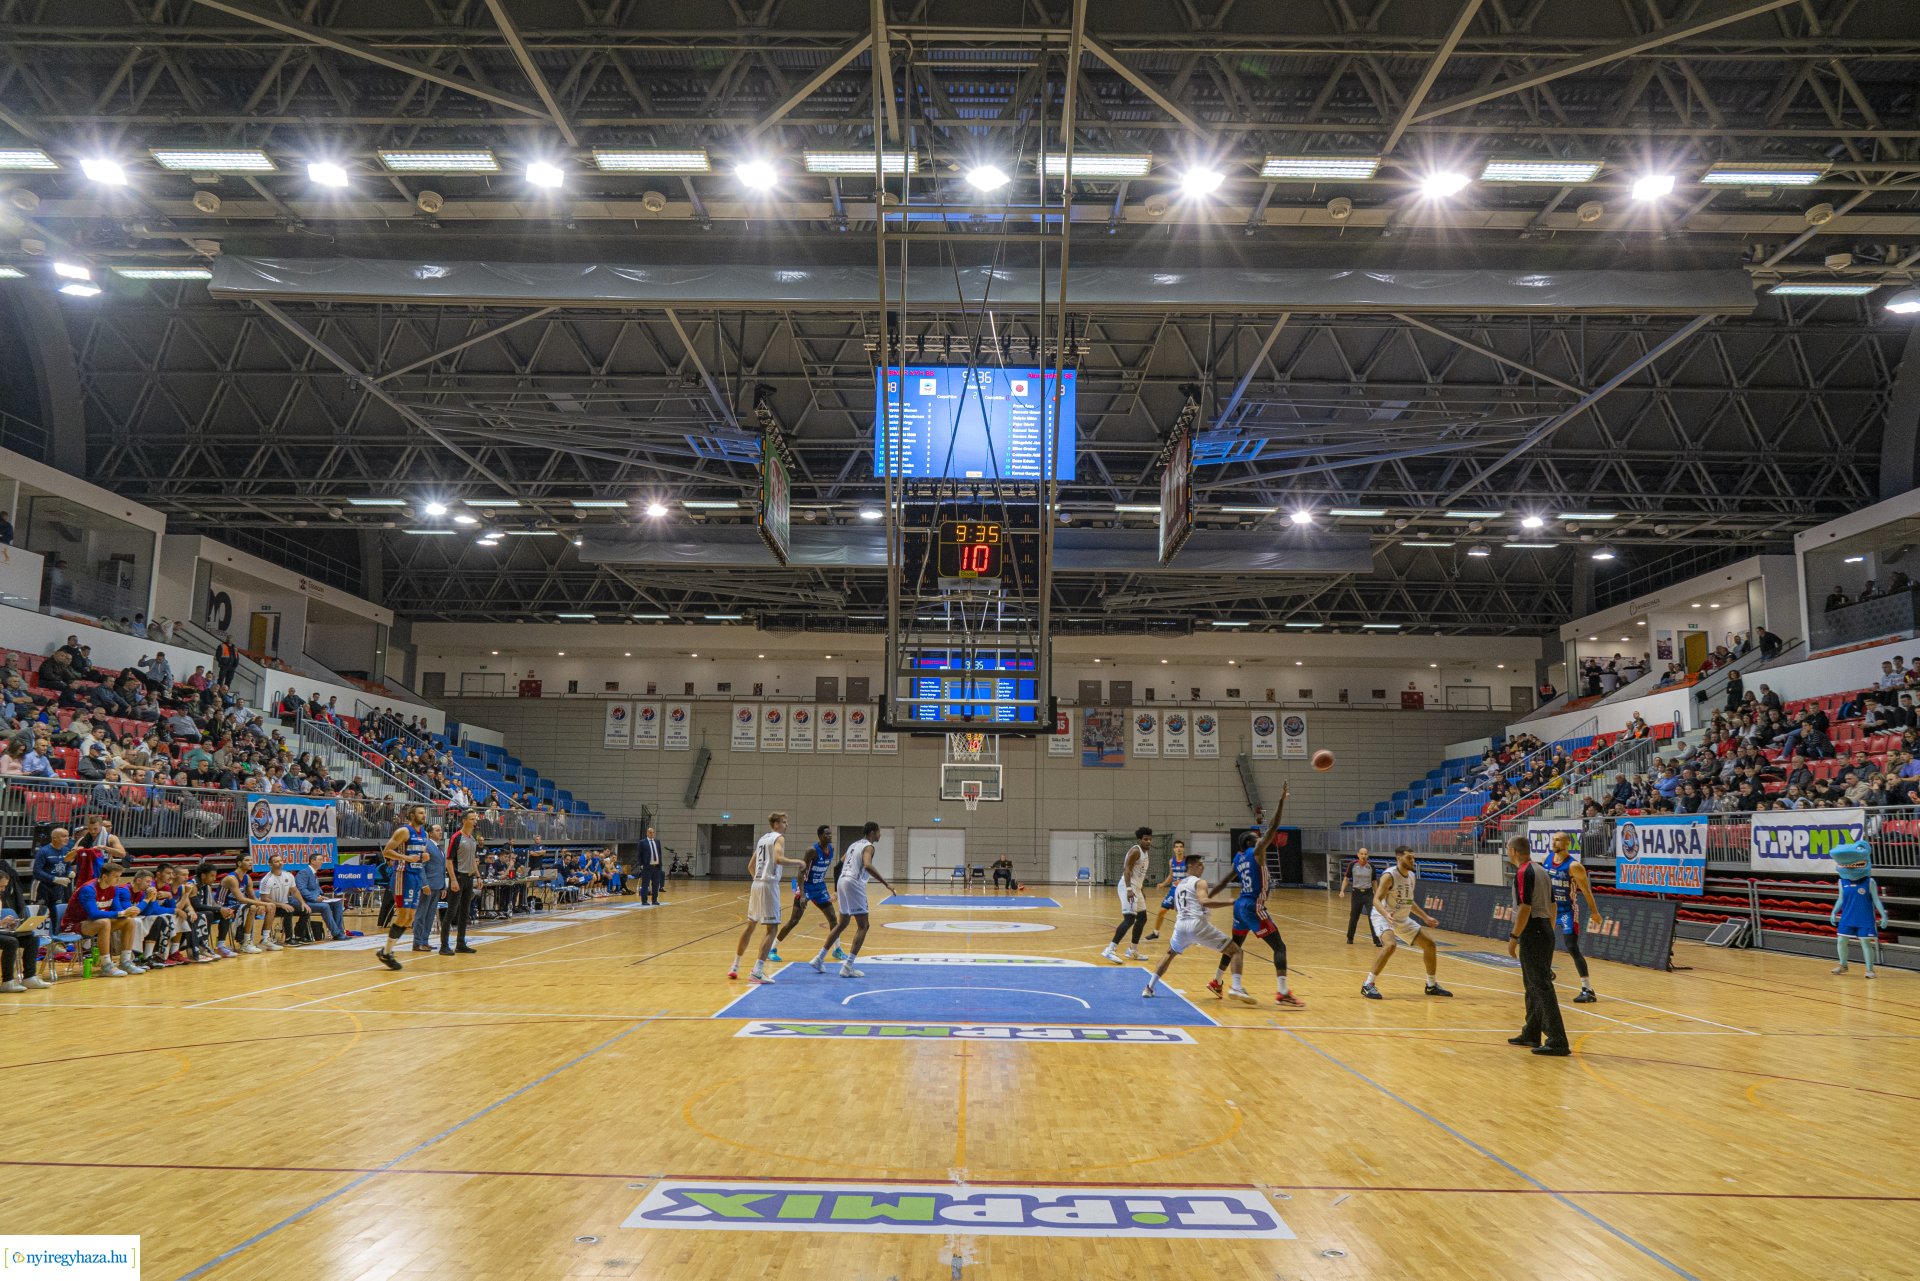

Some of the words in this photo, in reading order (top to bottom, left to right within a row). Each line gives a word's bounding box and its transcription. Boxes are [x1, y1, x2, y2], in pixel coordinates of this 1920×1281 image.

[956, 525, 998, 542] 9:35
[962, 545, 990, 572] 10
[275, 804, 330, 834] HAJRÁ
[1642, 822, 1702, 854] HAJRÁ
